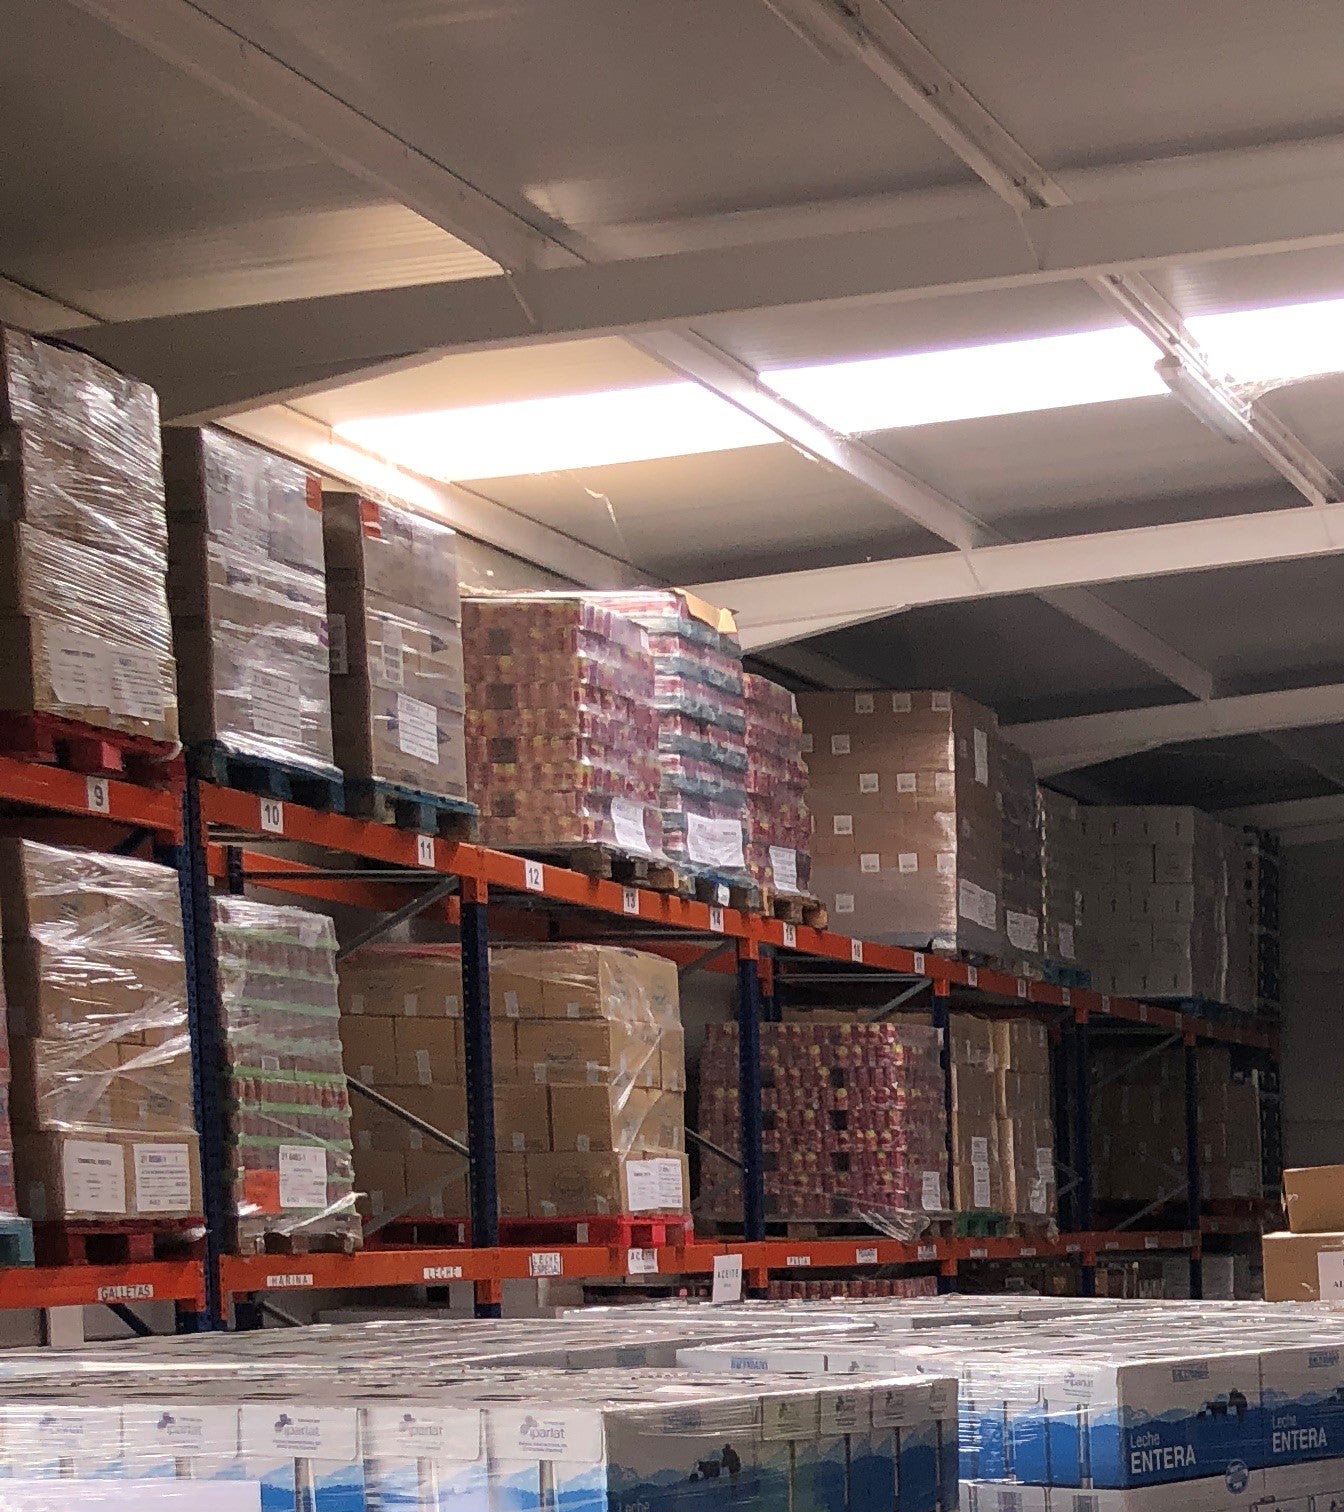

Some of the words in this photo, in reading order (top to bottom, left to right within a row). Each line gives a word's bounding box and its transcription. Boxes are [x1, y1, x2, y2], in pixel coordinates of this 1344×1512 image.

[95, 791, 104, 808] 9
[265, 804, 281, 826] 10
[420, 841, 433, 860] 11
[528, 867, 541, 885] 12
[101, 1286, 150, 1299] GALLETAS
[1131, 1431, 1160, 1448] Leche
[1272, 1428, 1328, 1453] ENTERA
[1131, 1445, 1197, 1475] ENTERA
